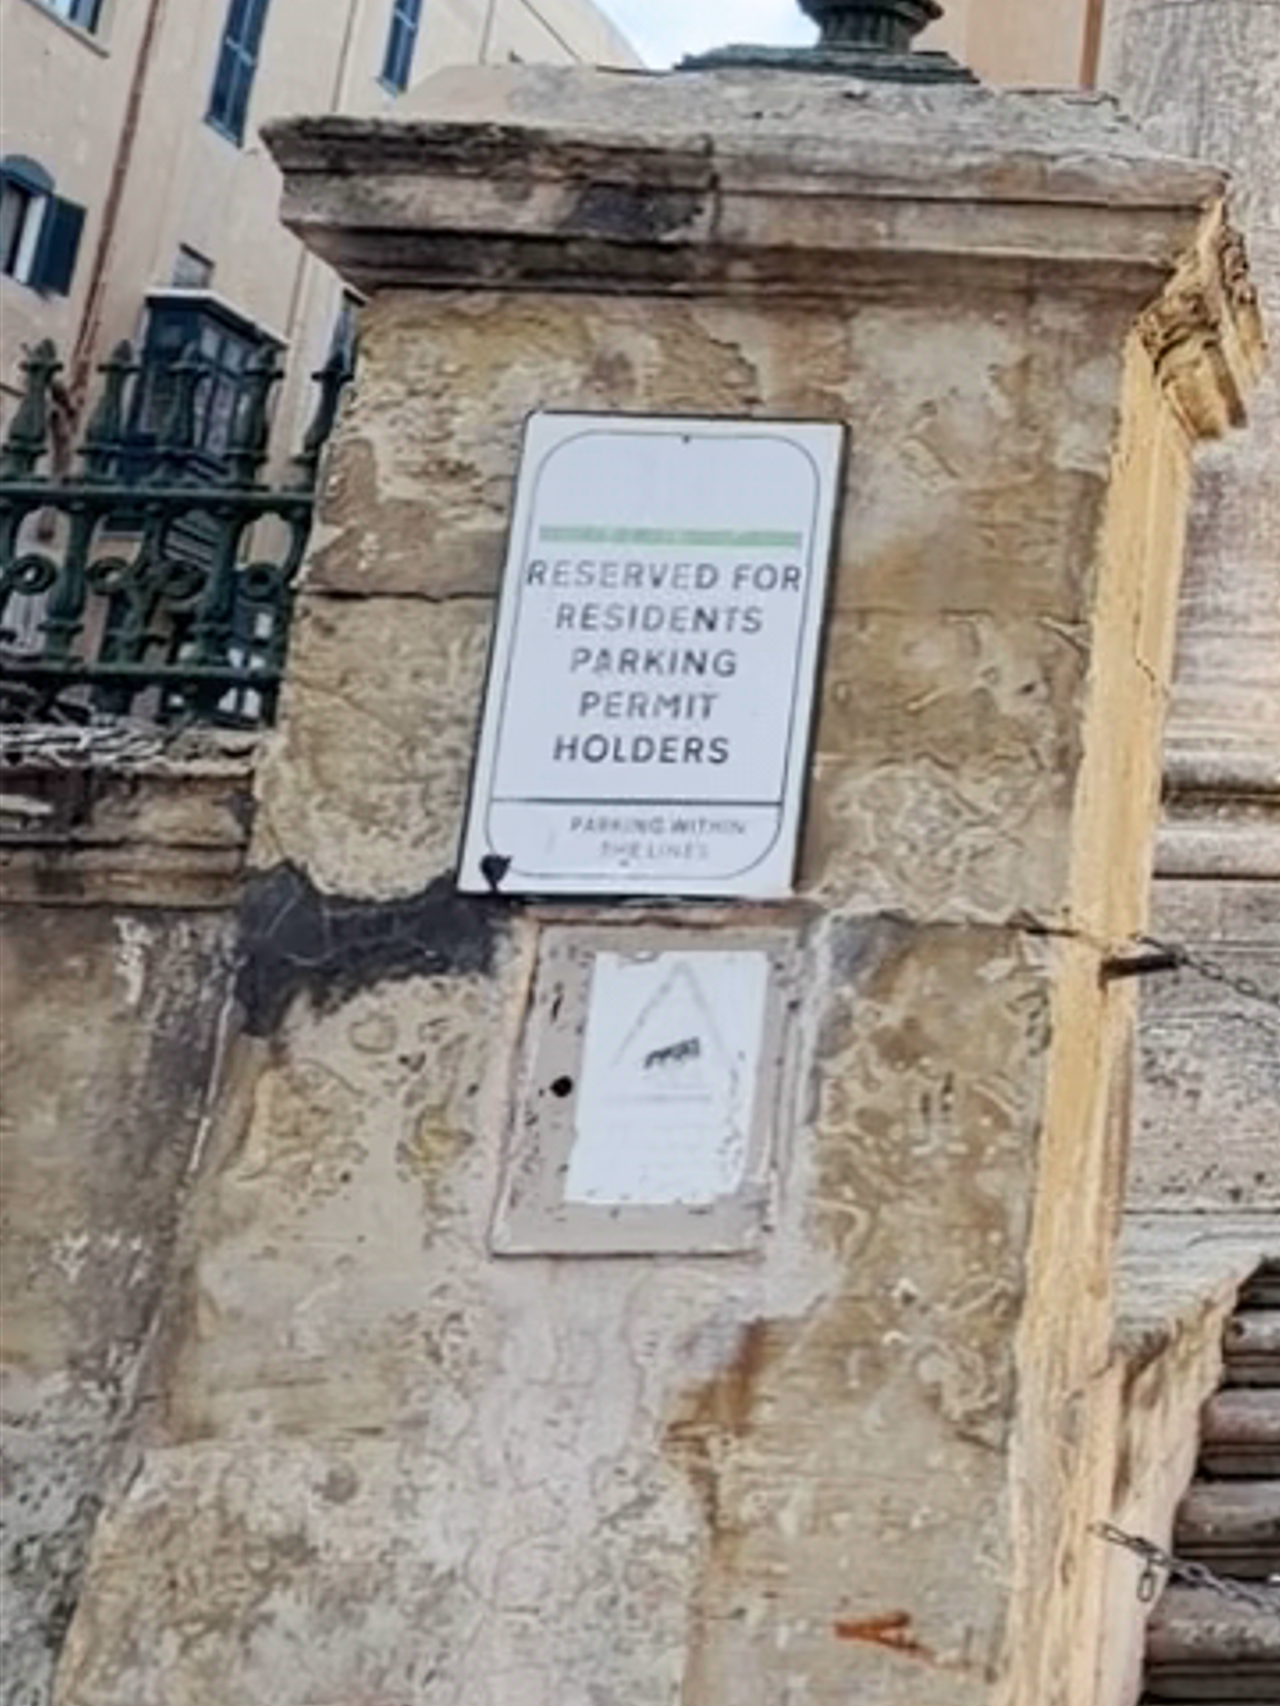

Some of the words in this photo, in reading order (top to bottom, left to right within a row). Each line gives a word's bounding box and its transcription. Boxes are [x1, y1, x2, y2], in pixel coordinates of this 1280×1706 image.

[526, 559, 719, 590] RESERVED
[731, 562, 802, 592] FOR
[556, 604, 763, 634] RESIDENTS
[570, 646, 738, 677] PARKING
[578, 691, 720, 721] PERMIT
[552, 734, 731, 765] HOLDERS
[570, 816, 666, 835] PARKING
[670, 817, 746, 835] WITHIN
